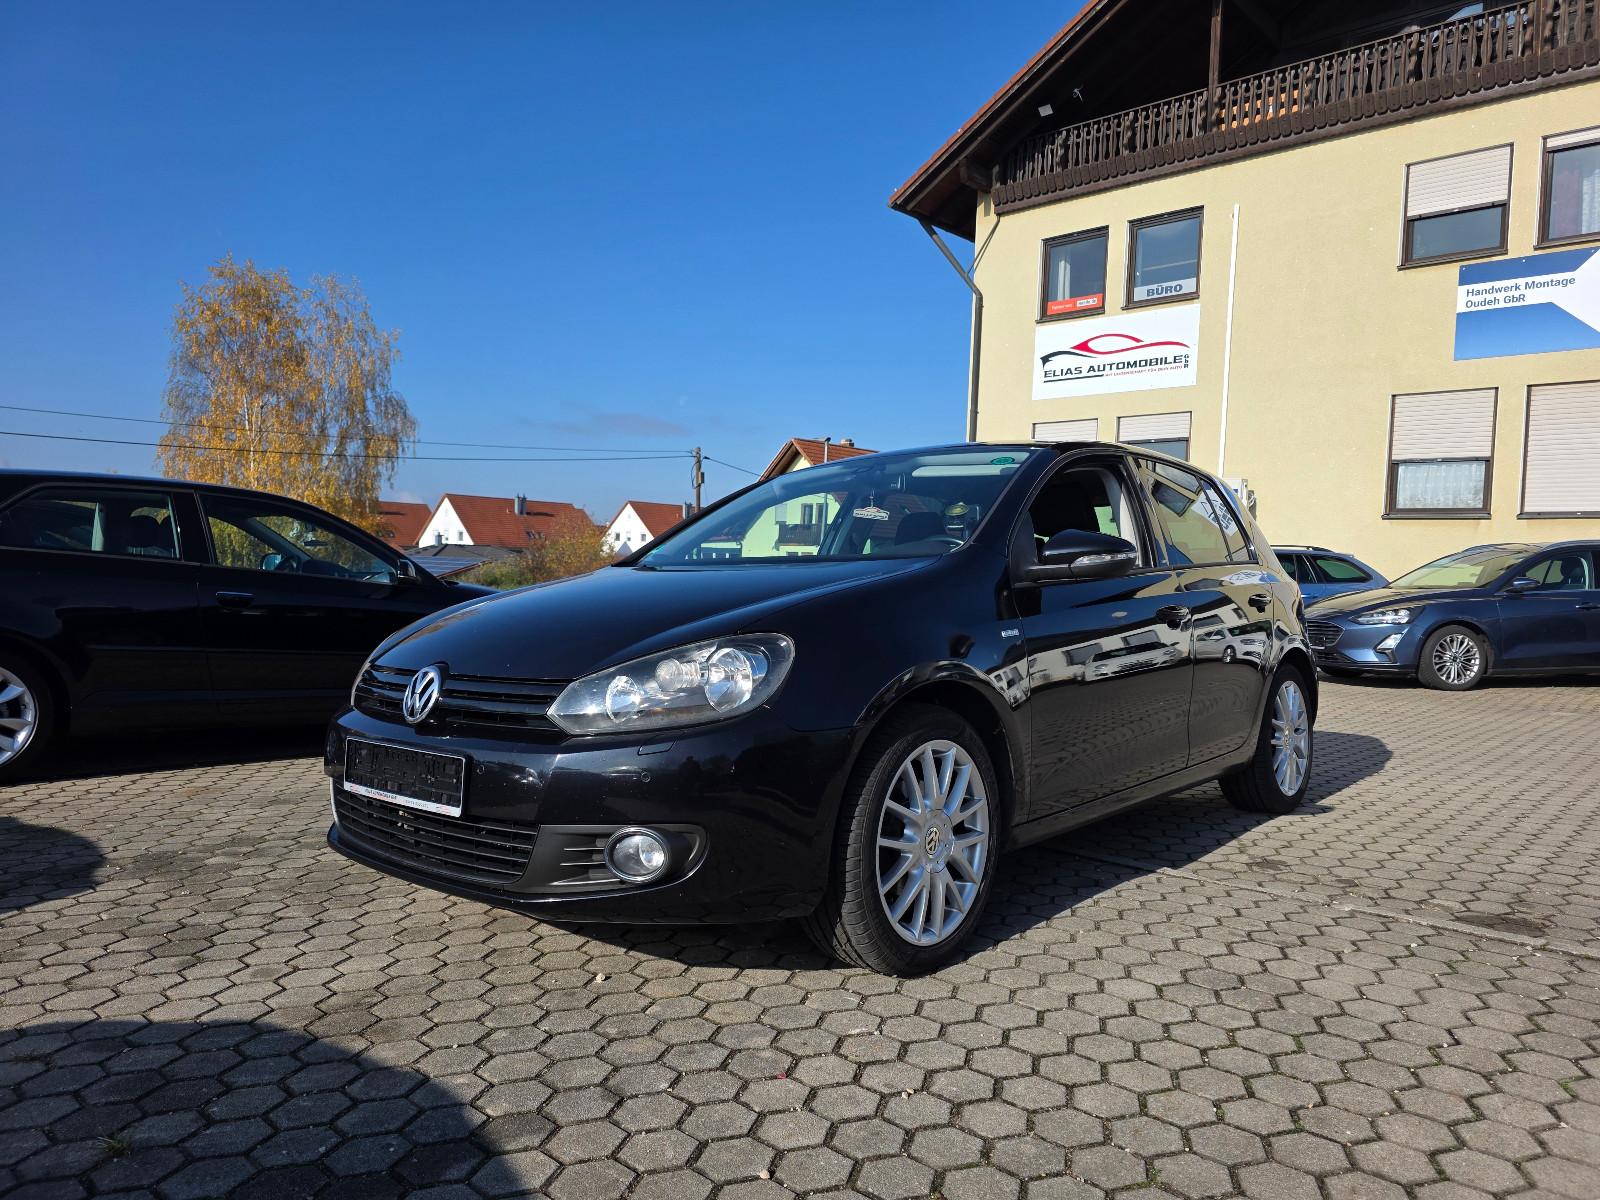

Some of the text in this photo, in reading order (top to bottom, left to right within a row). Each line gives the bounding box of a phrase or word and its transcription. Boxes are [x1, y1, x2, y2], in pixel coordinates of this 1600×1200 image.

[1146, 284, 1183, 297] BÜRO
[1466, 276, 1576, 297] Handwerk Montage
[1465, 293, 1526, 309] Oudeh GbR
[1043, 354, 1183, 378] ELIAS AUTOMOBILE
